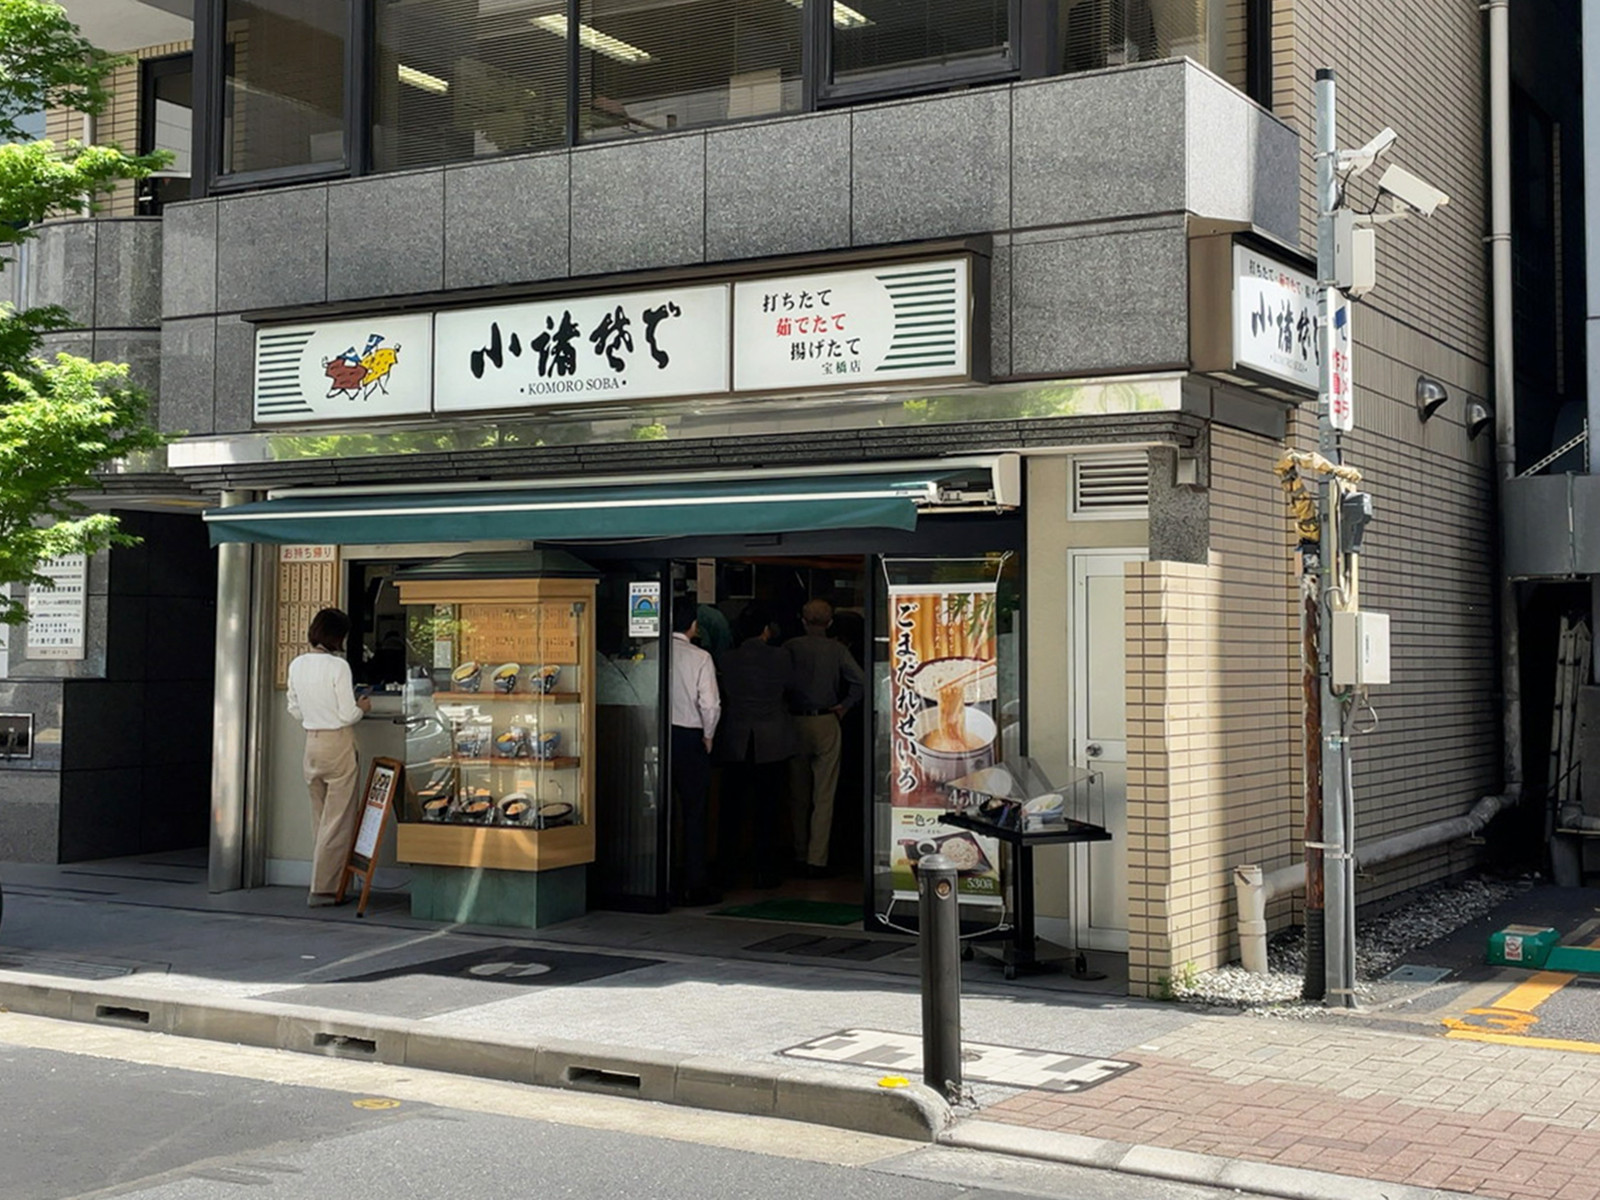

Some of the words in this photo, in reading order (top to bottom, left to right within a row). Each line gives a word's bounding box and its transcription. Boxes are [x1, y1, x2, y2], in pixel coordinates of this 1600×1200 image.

[763, 289, 831, 313] 打ちたて
[777, 313, 847, 337] 茹でたて
[791, 338, 860, 360] 揚げたて
[821, 359, 860, 375] 宝橋店
[528, 380, 584, 396] KOMORO
[586, 378, 620, 391] SOBA
[283, 546, 332, 559] お持ち帰り
[896, 602, 920, 794] ごまだれせいろ
